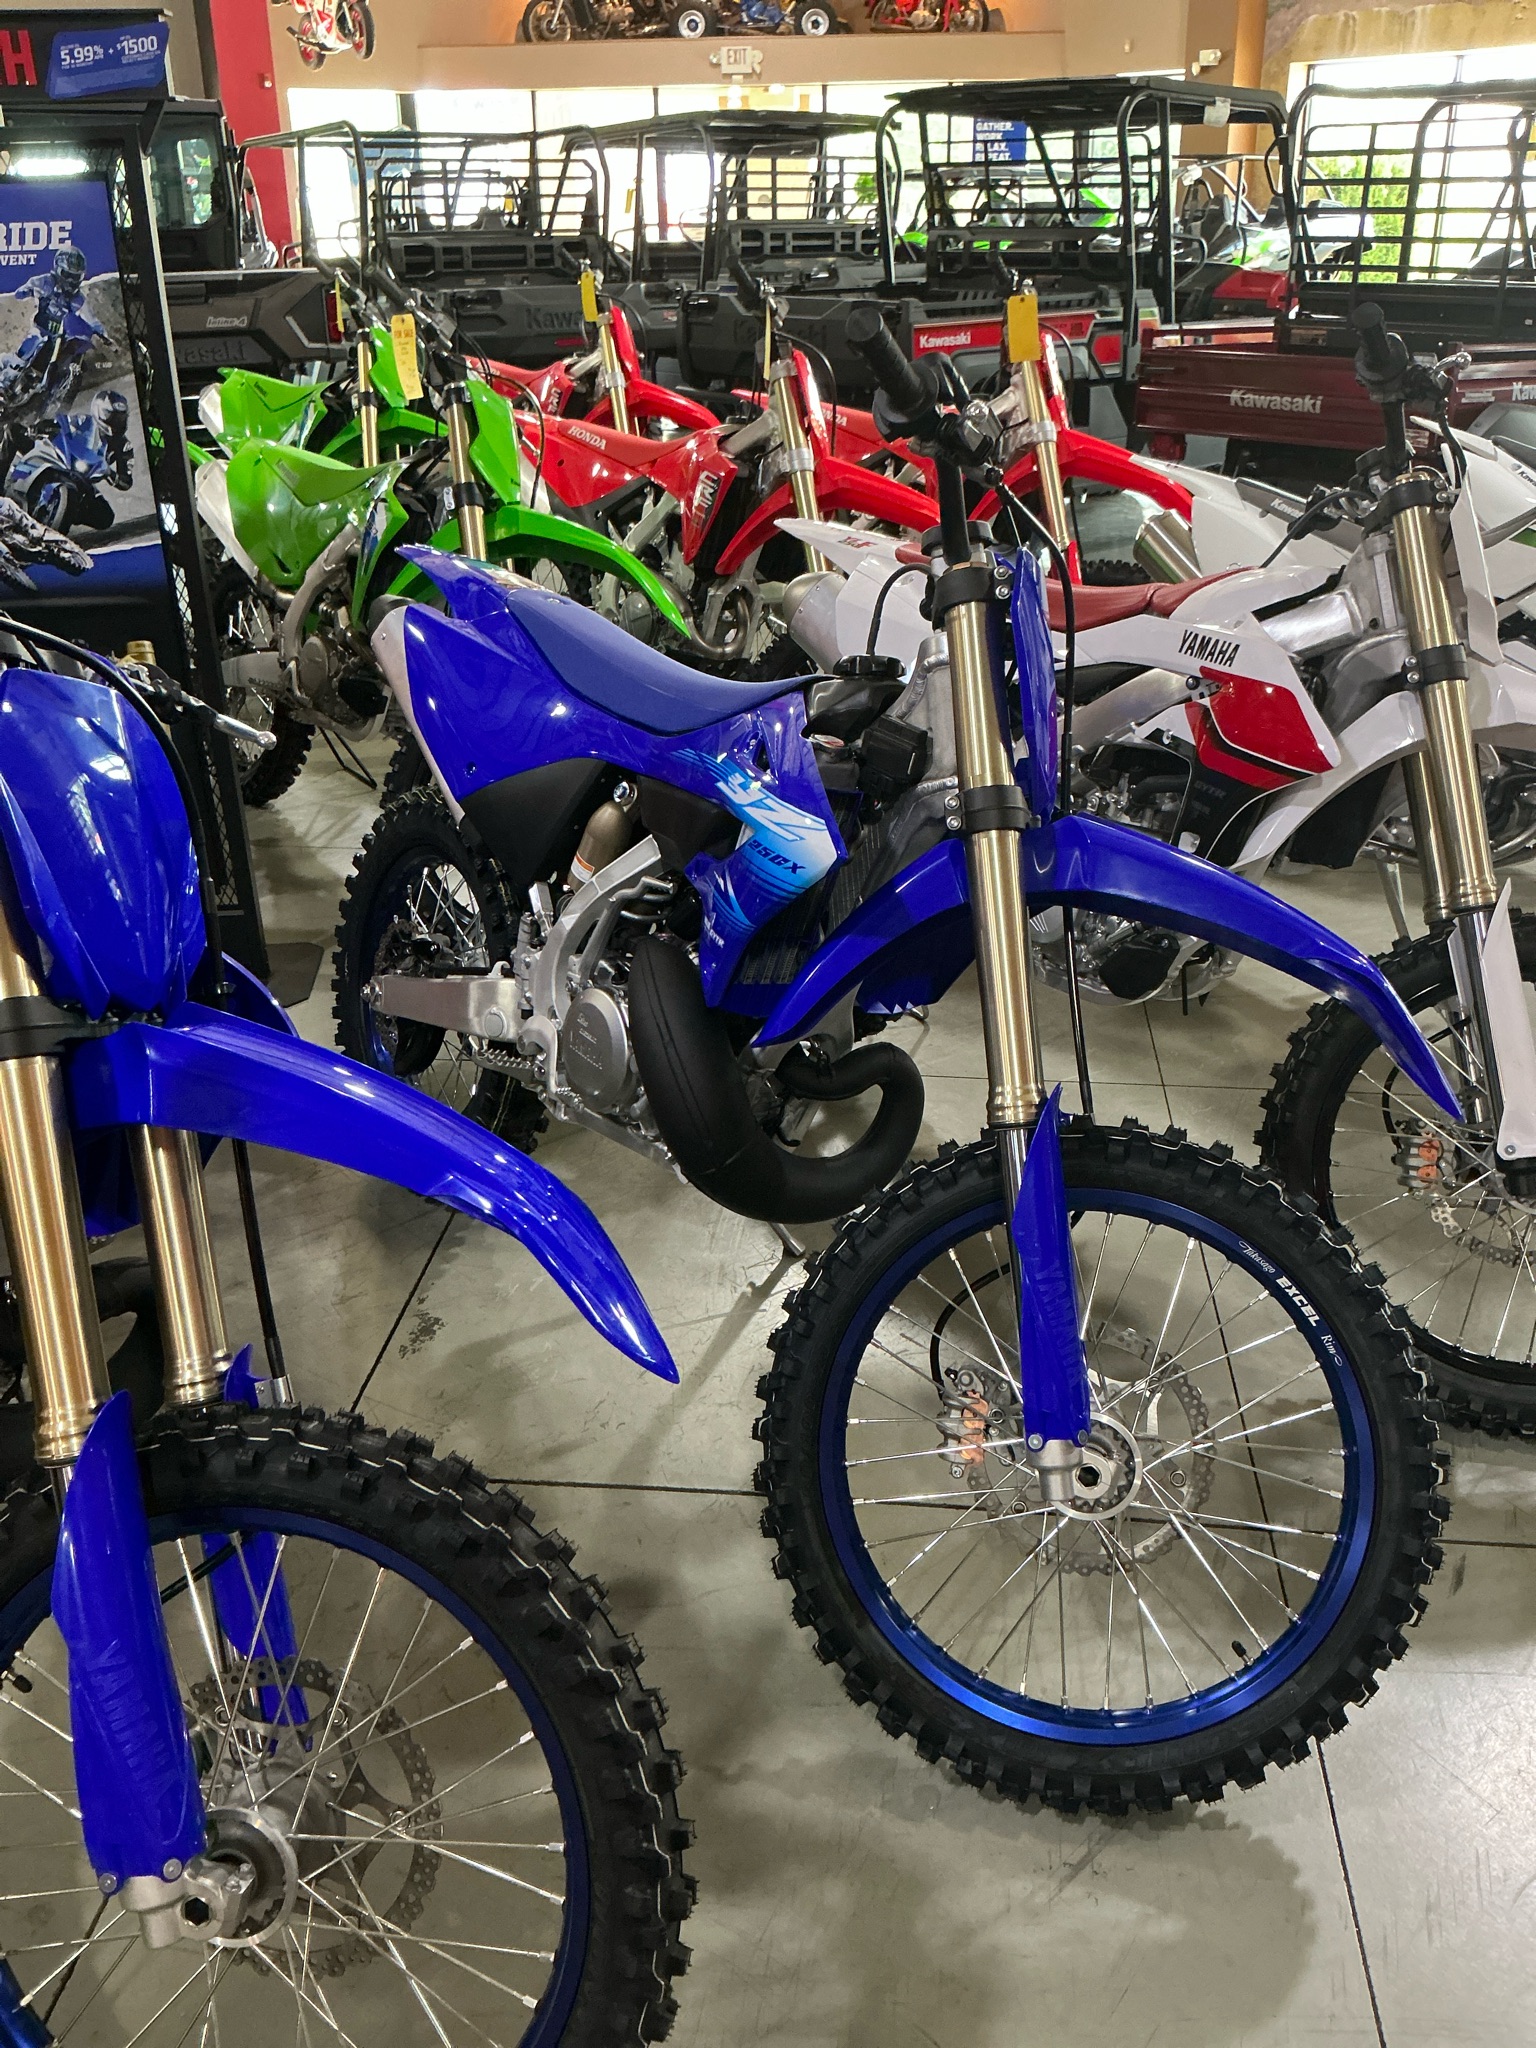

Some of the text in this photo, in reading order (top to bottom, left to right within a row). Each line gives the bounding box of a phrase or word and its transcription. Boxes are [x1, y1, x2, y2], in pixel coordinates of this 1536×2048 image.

[116, 35, 158, 56] $1500
[726, 47, 748, 66] EXIT
[0, 29, 38, 86] H
[974, 152, 1013, 162] RPEAT.
[975, 141, 1009, 152] RLAX.
[0, 253, 38, 266] VENT
[525, 306, 583, 331] Kawa
[919, 331, 971, 349] Kawasaki
[1229, 388, 1324, 414] Kawasaki
[1511, 381, 1536, 401] Kaw
[567, 425, 607, 451] HONDA
[1177, 628, 1241, 668] YAMAHA
[1238, 1240, 1343, 1367] Takasago EXCEL Rim
[84, 1638, 180, 1804] YAMAHA
